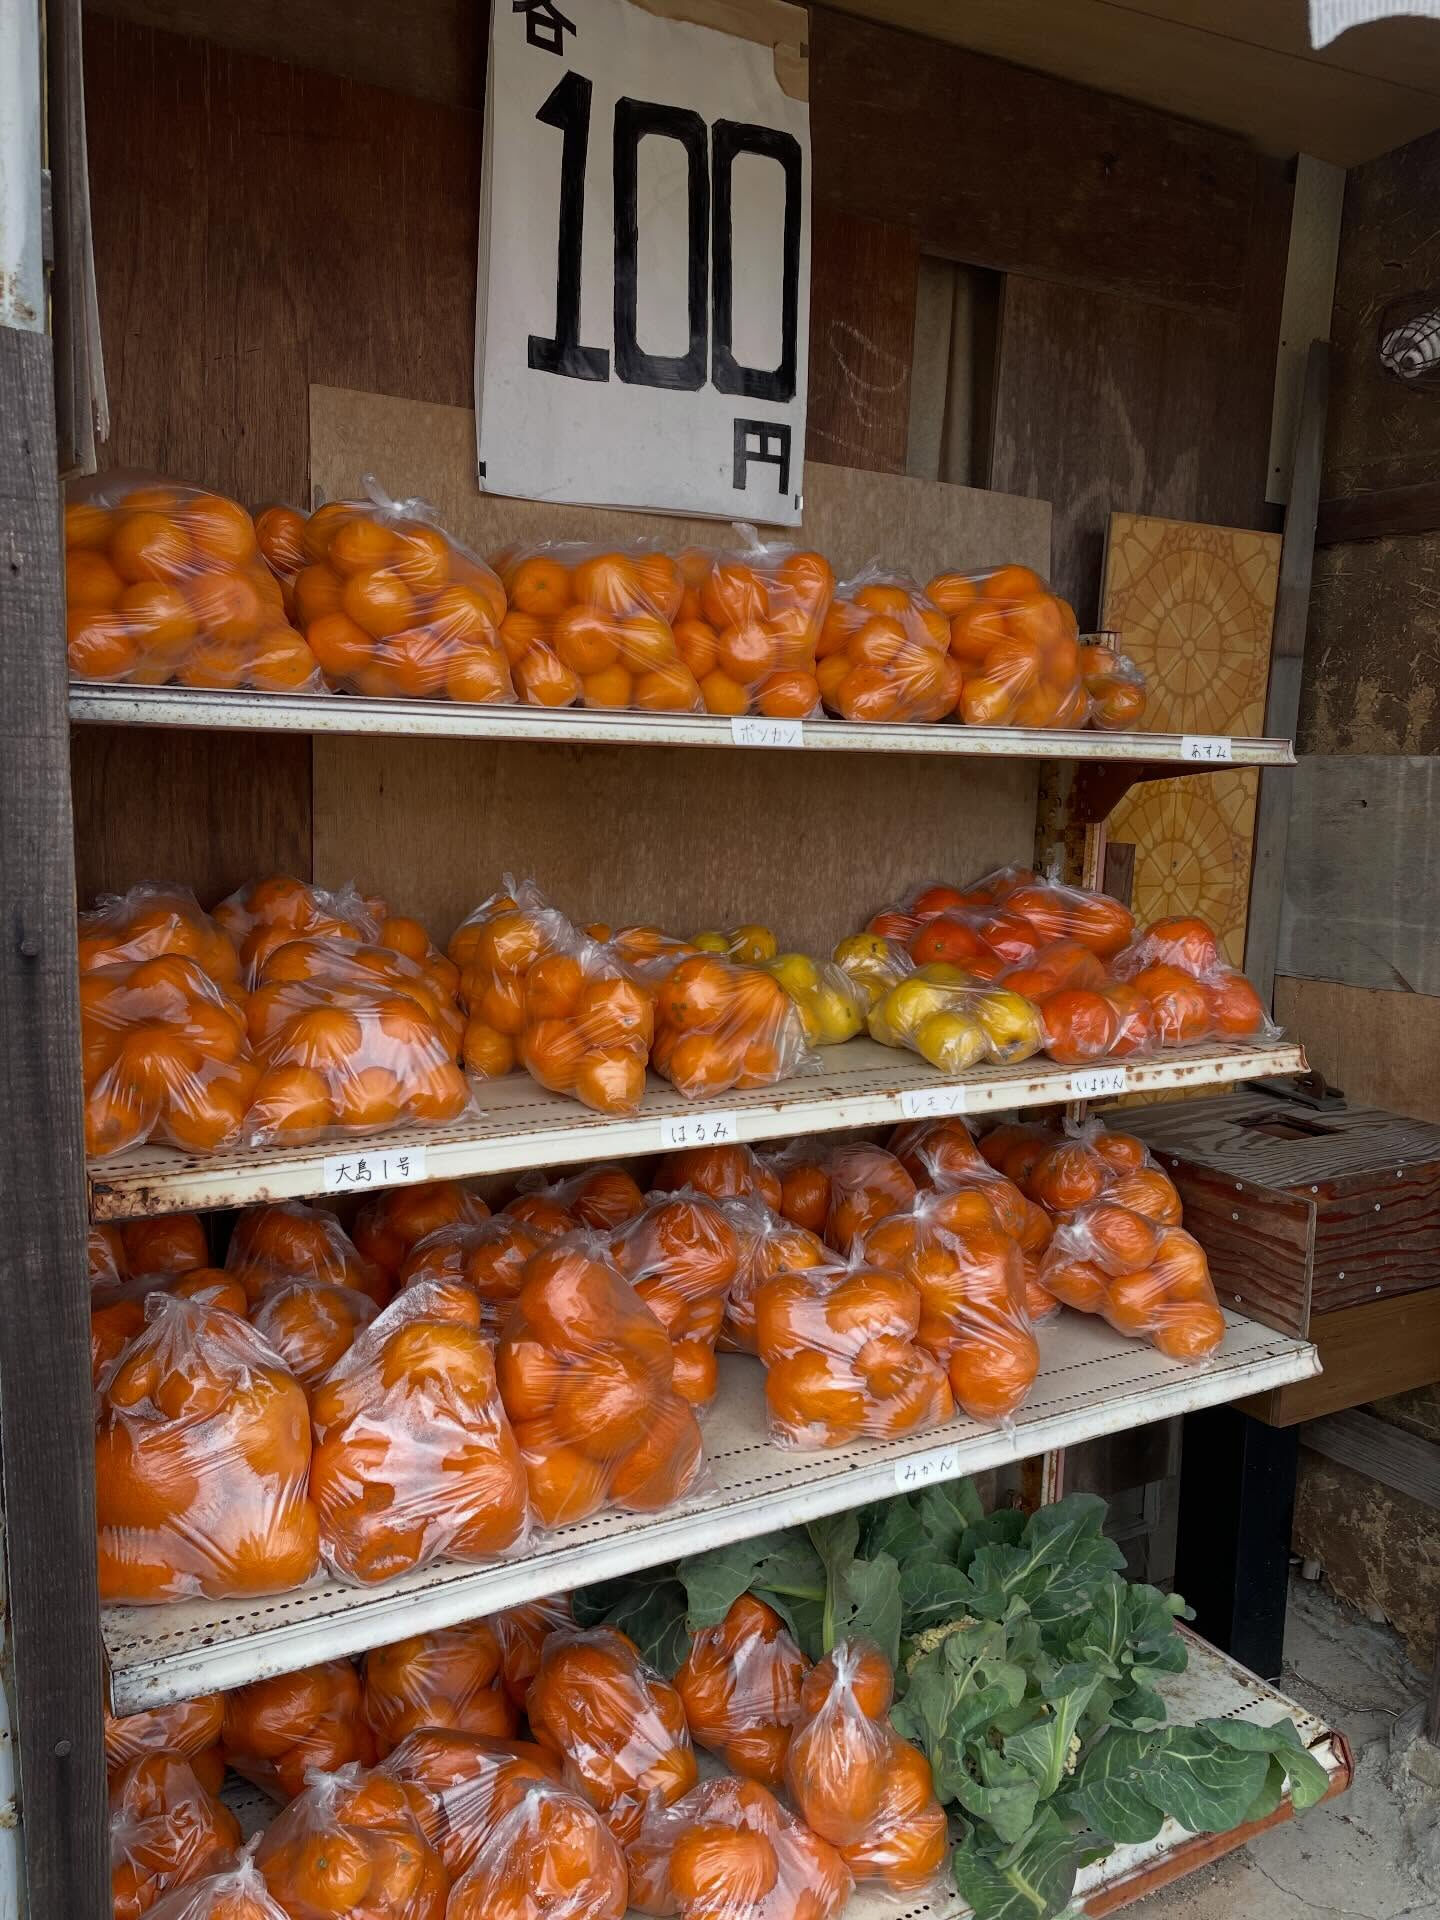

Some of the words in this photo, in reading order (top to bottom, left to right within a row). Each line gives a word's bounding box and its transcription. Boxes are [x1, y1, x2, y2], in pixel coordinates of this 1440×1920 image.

[527, 70, 802, 403] 100
[733, 418, 792, 495] 円
[739, 722, 798, 745] ポンカン
[1191, 743, 1227, 760] あすみ
[1076, 1074, 1124, 1093] いよかん
[911, 1094, 960, 1115] レモン
[671, 1121, 729, 1144] はるみ
[904, 1455, 953, 1481] みかん
